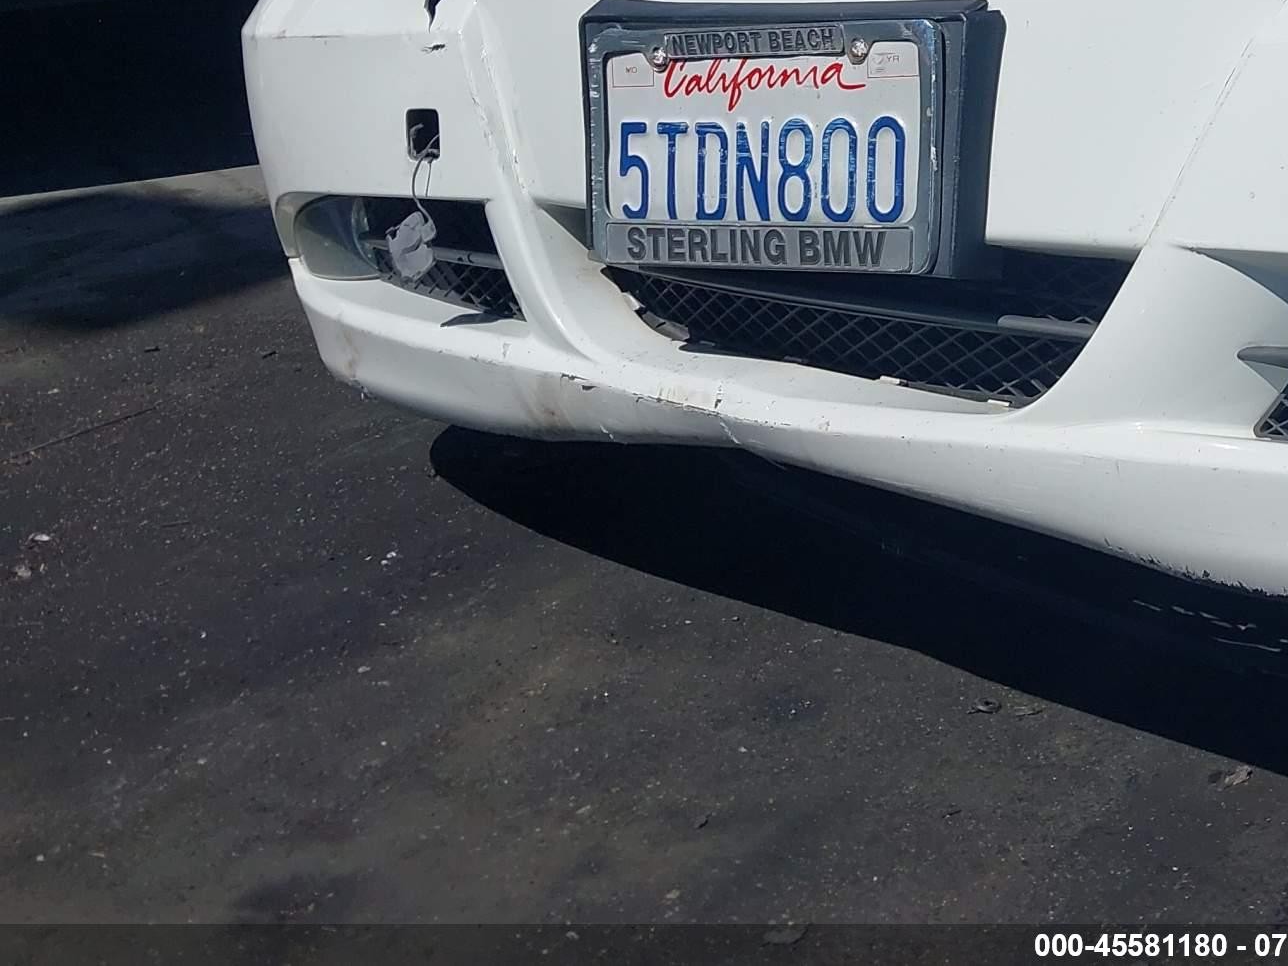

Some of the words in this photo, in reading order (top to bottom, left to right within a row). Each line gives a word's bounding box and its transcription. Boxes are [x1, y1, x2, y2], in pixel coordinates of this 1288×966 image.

[670, 30, 762, 54] NEWPORT
[769, 28, 835, 52] BEACH
[664, 57, 866, 111] California
[619, 115, 906, 223] 5TDN800
[626, 227, 787, 265] STERLING
[799, 230, 887, 267] BMW
